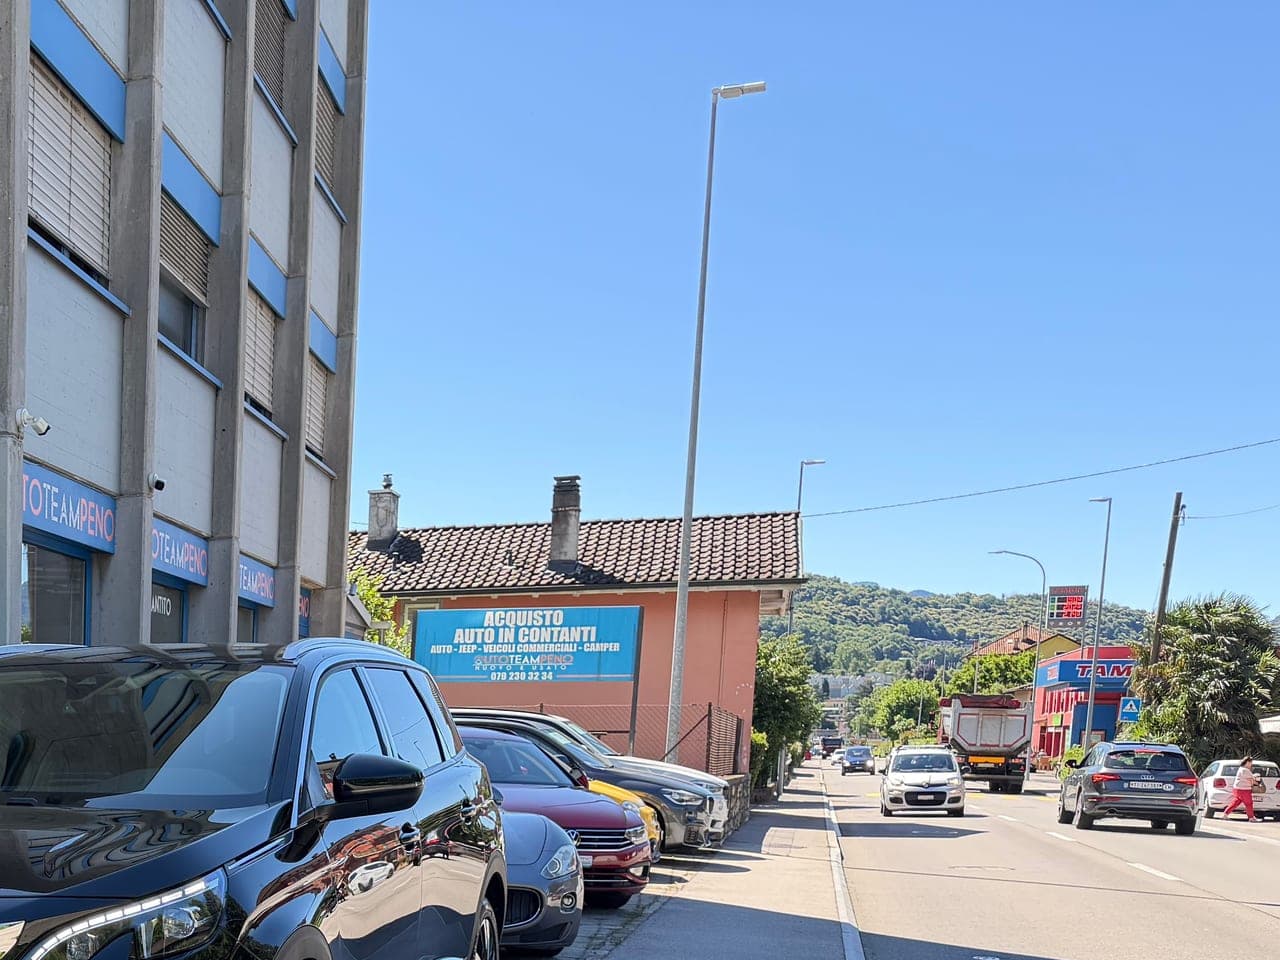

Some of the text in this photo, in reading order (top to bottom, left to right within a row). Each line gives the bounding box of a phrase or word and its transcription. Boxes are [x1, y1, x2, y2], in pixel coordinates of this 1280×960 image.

[484, 610, 564, 628] ACQUISTO
[453, 626, 597, 644] AUTO IN CONTANTI
[430, 645, 453, 654] AUTO
[458, 645, 477, 654] JEEP
[483, 644, 515, 653] VEICOLI
[516, 643, 577, 653] COMMERCIALI
[583, 642, 620, 652] CAMPER
